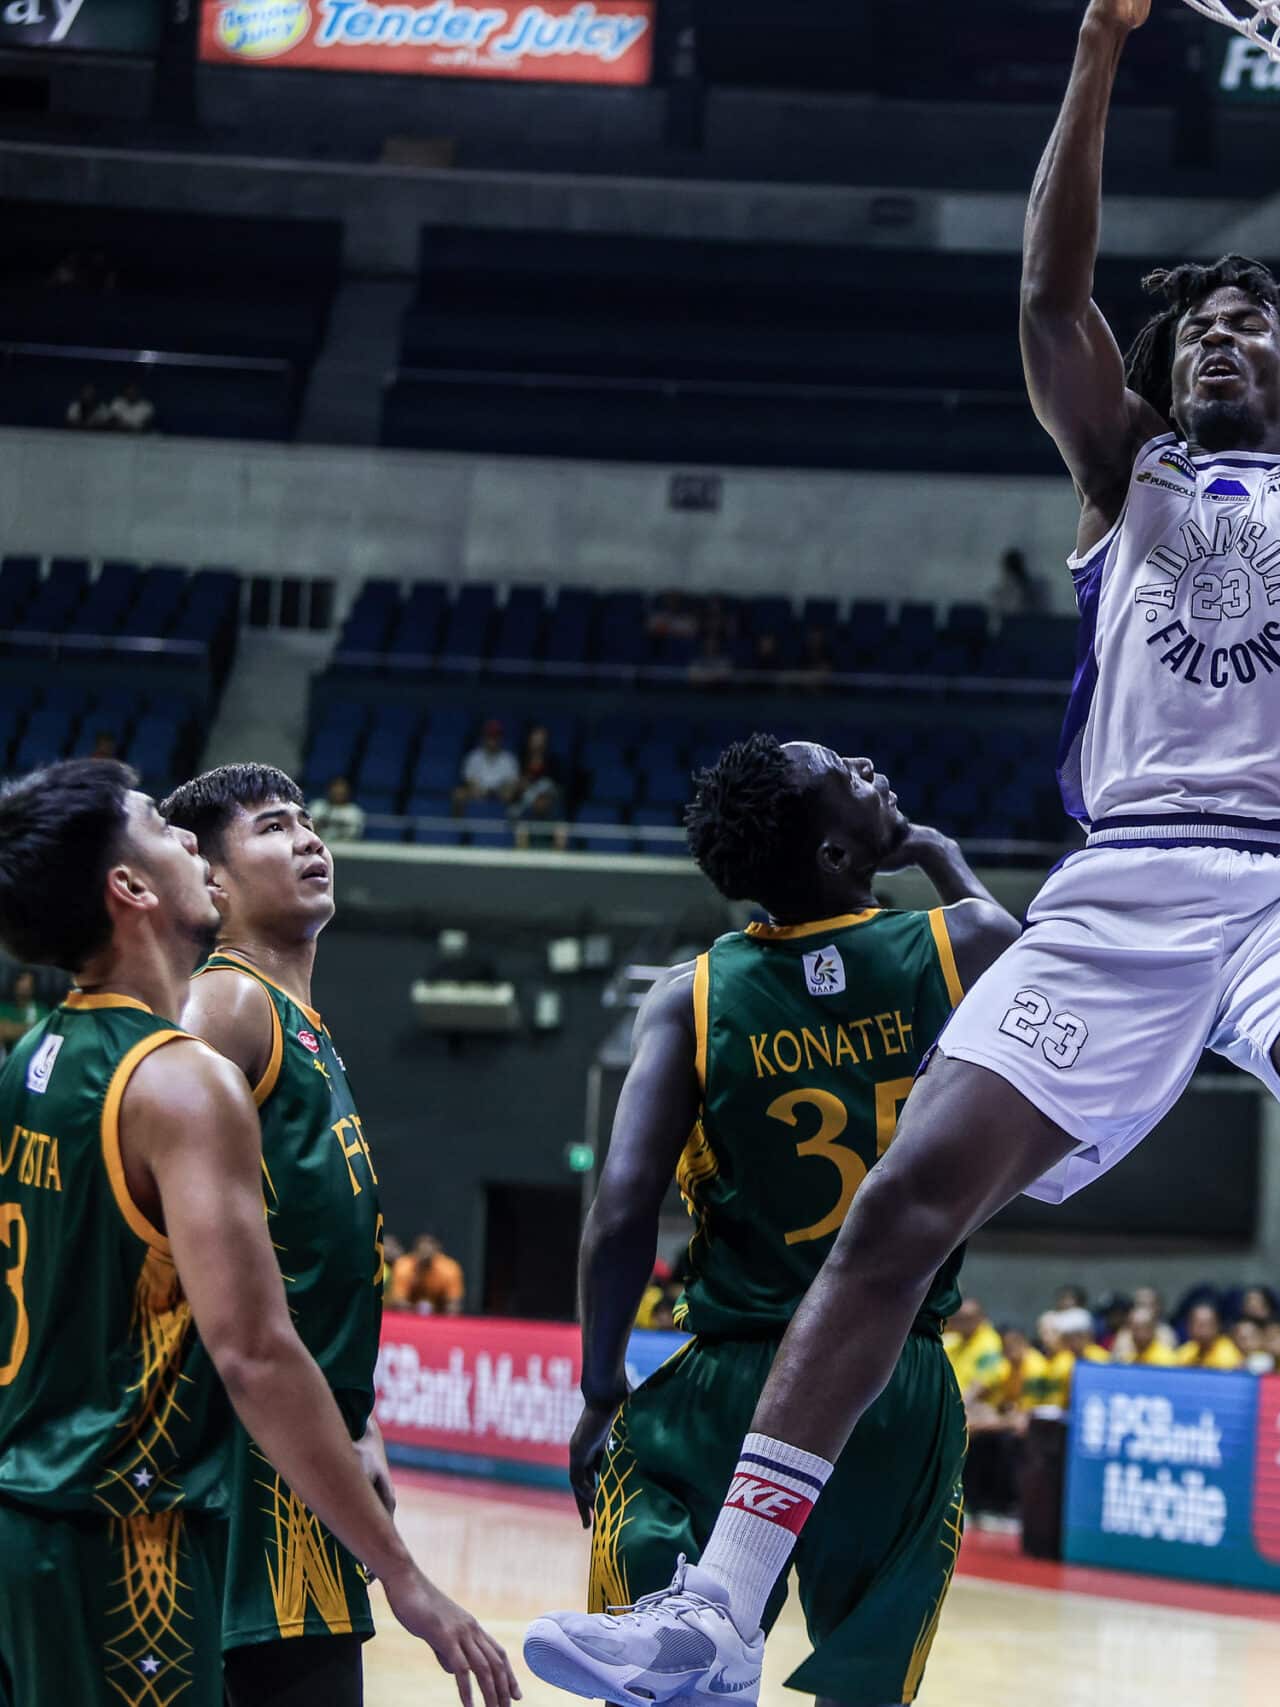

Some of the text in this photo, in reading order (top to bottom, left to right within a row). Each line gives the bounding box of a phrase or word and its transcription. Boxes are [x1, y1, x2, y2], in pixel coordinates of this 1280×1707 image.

[316, 0, 648, 61] Tender Juicy
[1191, 568, 1251, 621] 23
[998, 989, 1089, 1069] 23
[1102, 1462, 1227, 1546] Mobile
